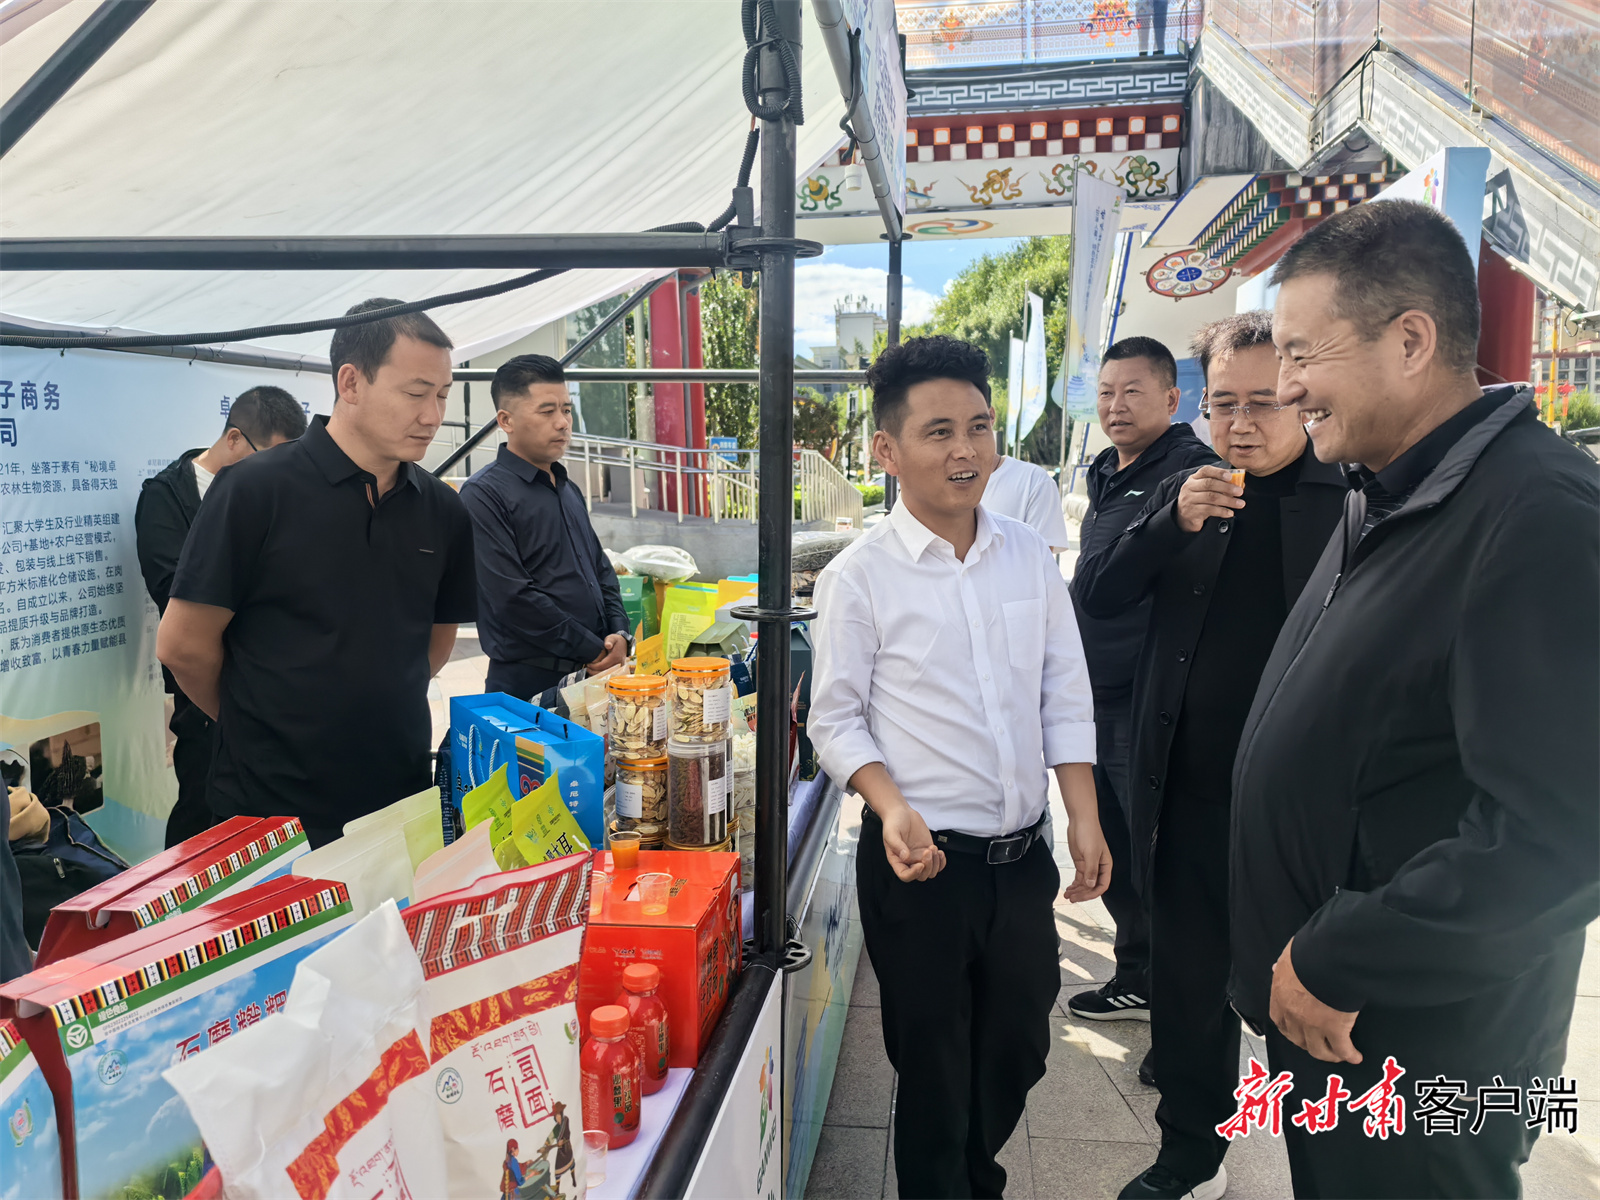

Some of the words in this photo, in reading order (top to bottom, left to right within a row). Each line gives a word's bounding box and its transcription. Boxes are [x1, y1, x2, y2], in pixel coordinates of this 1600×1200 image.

[0, 380, 60, 411] 子商务
[484, 1066, 519, 1133] 石磨
[516, 1053, 551, 1118] 豆面
